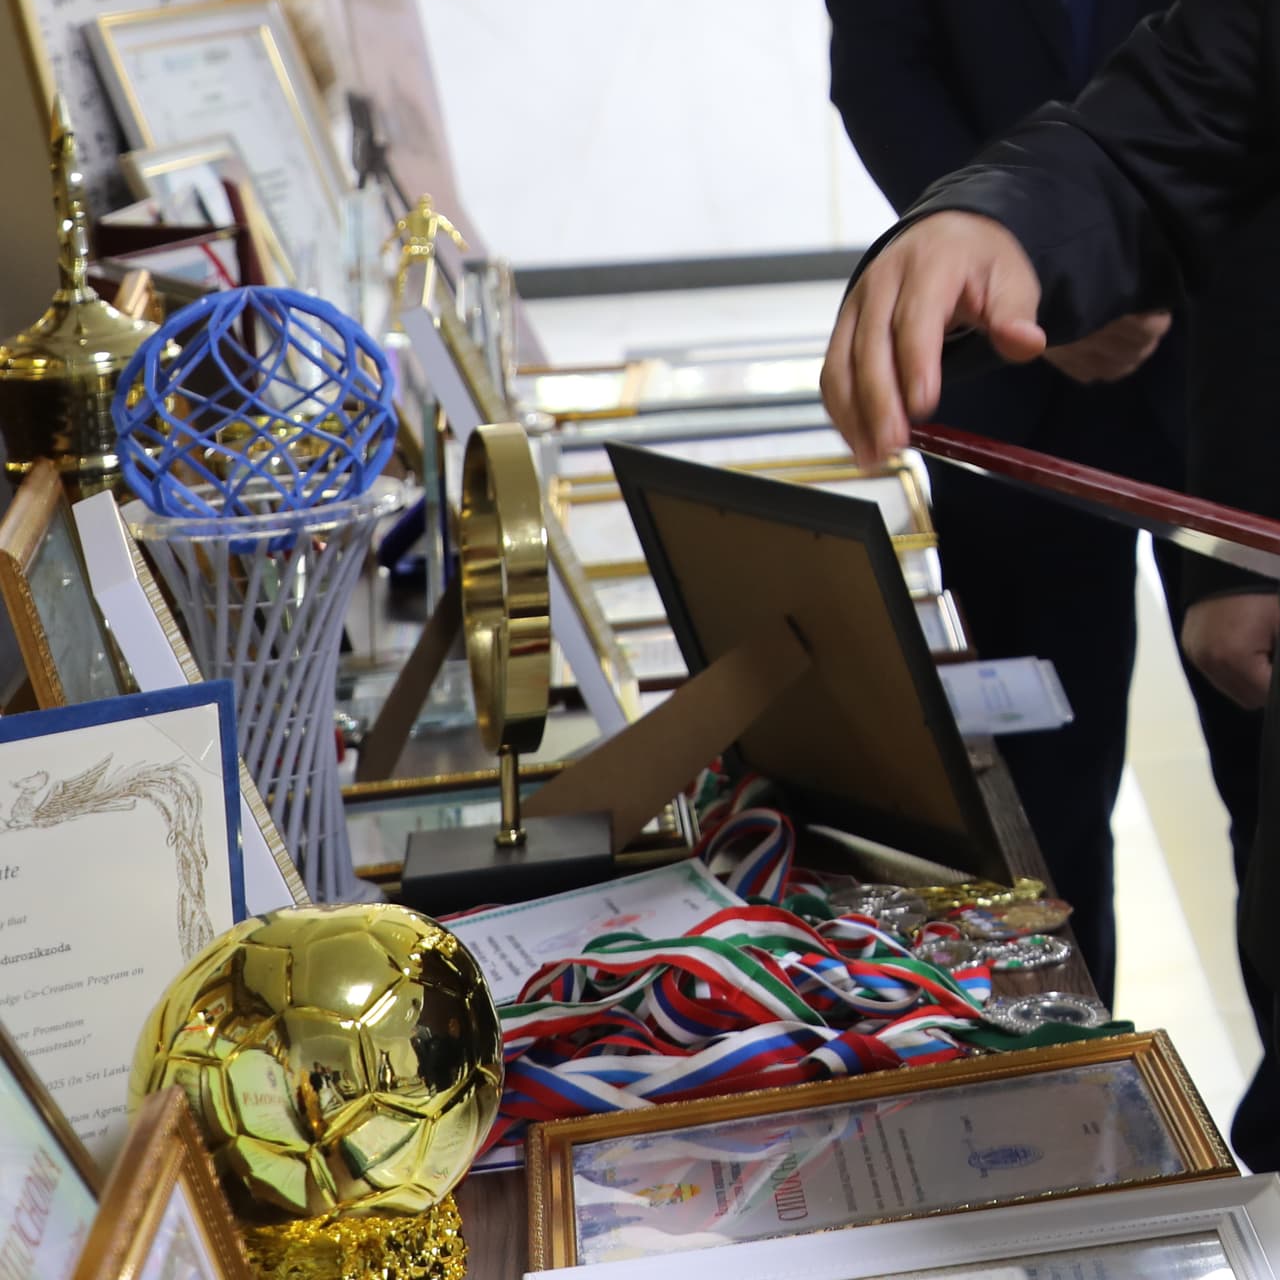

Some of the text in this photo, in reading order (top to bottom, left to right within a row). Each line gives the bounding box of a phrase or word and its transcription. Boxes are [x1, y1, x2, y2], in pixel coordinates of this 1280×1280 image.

[0, 942, 72, 966] durozikzoda
[23, 981, 84, 1001] Co-Creation
[87, 970, 129, 986] Program
[131, 967, 144, 977] on
